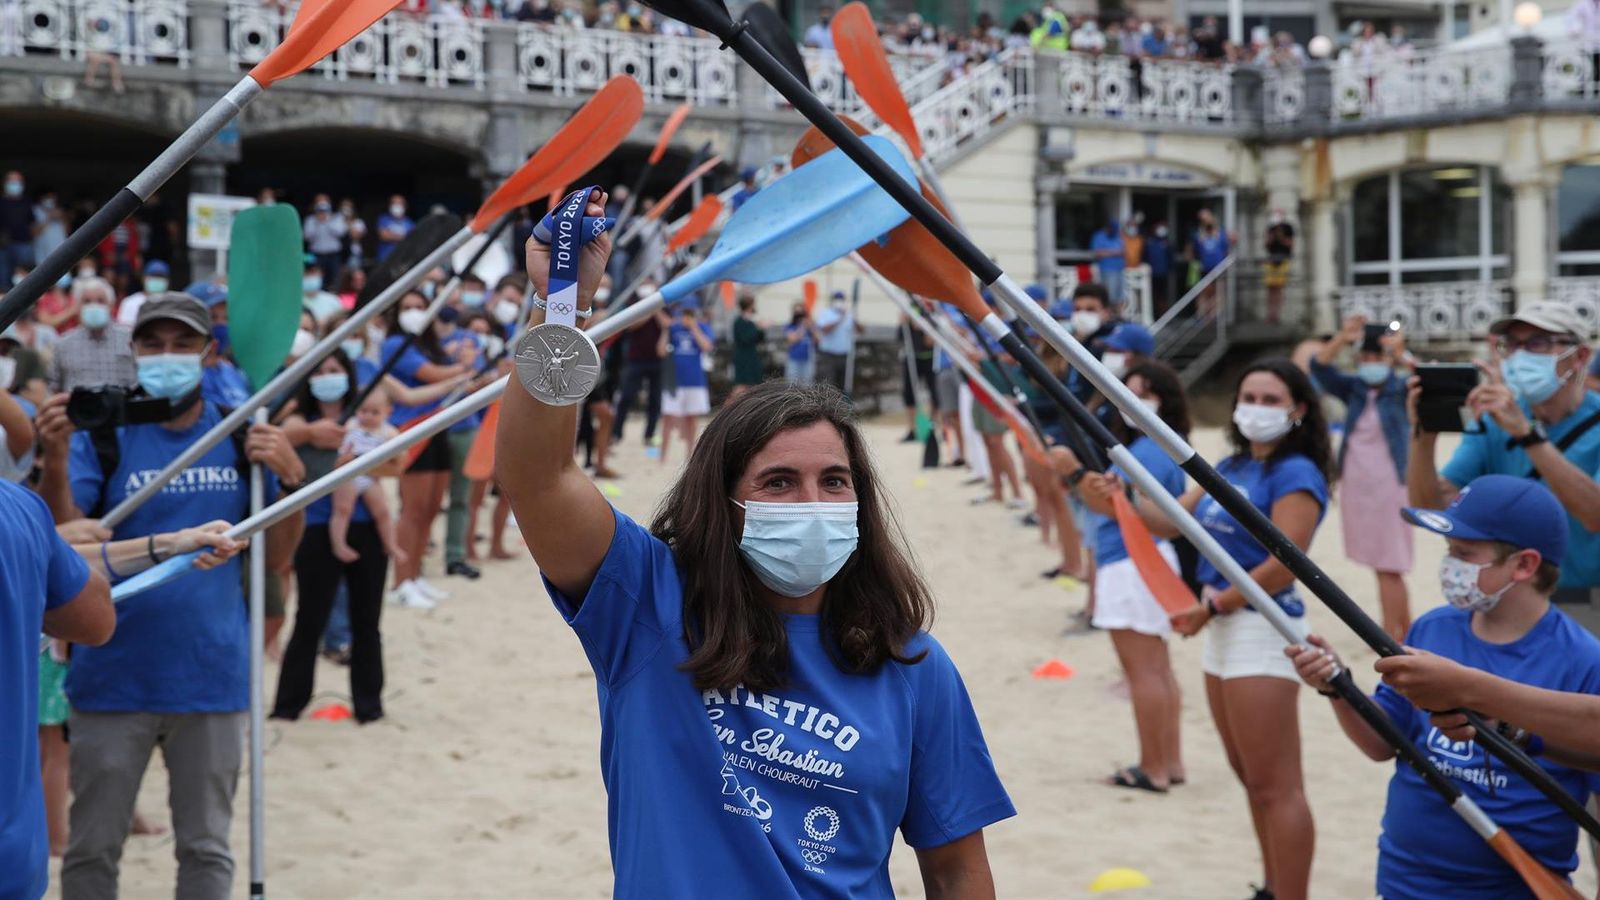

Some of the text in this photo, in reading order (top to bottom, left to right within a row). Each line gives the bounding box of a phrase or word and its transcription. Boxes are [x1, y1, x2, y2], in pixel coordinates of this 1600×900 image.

[557, 190, 586, 270] TOKYO 2020
[125, 465, 239, 490] ATETIKO
[702, 682, 860, 752] ATLETICO
[740, 728, 845, 779] Sebastian
[757, 763, 821, 790] CHOURRAUT
[797, 838, 837, 854] TOKYO 2020
